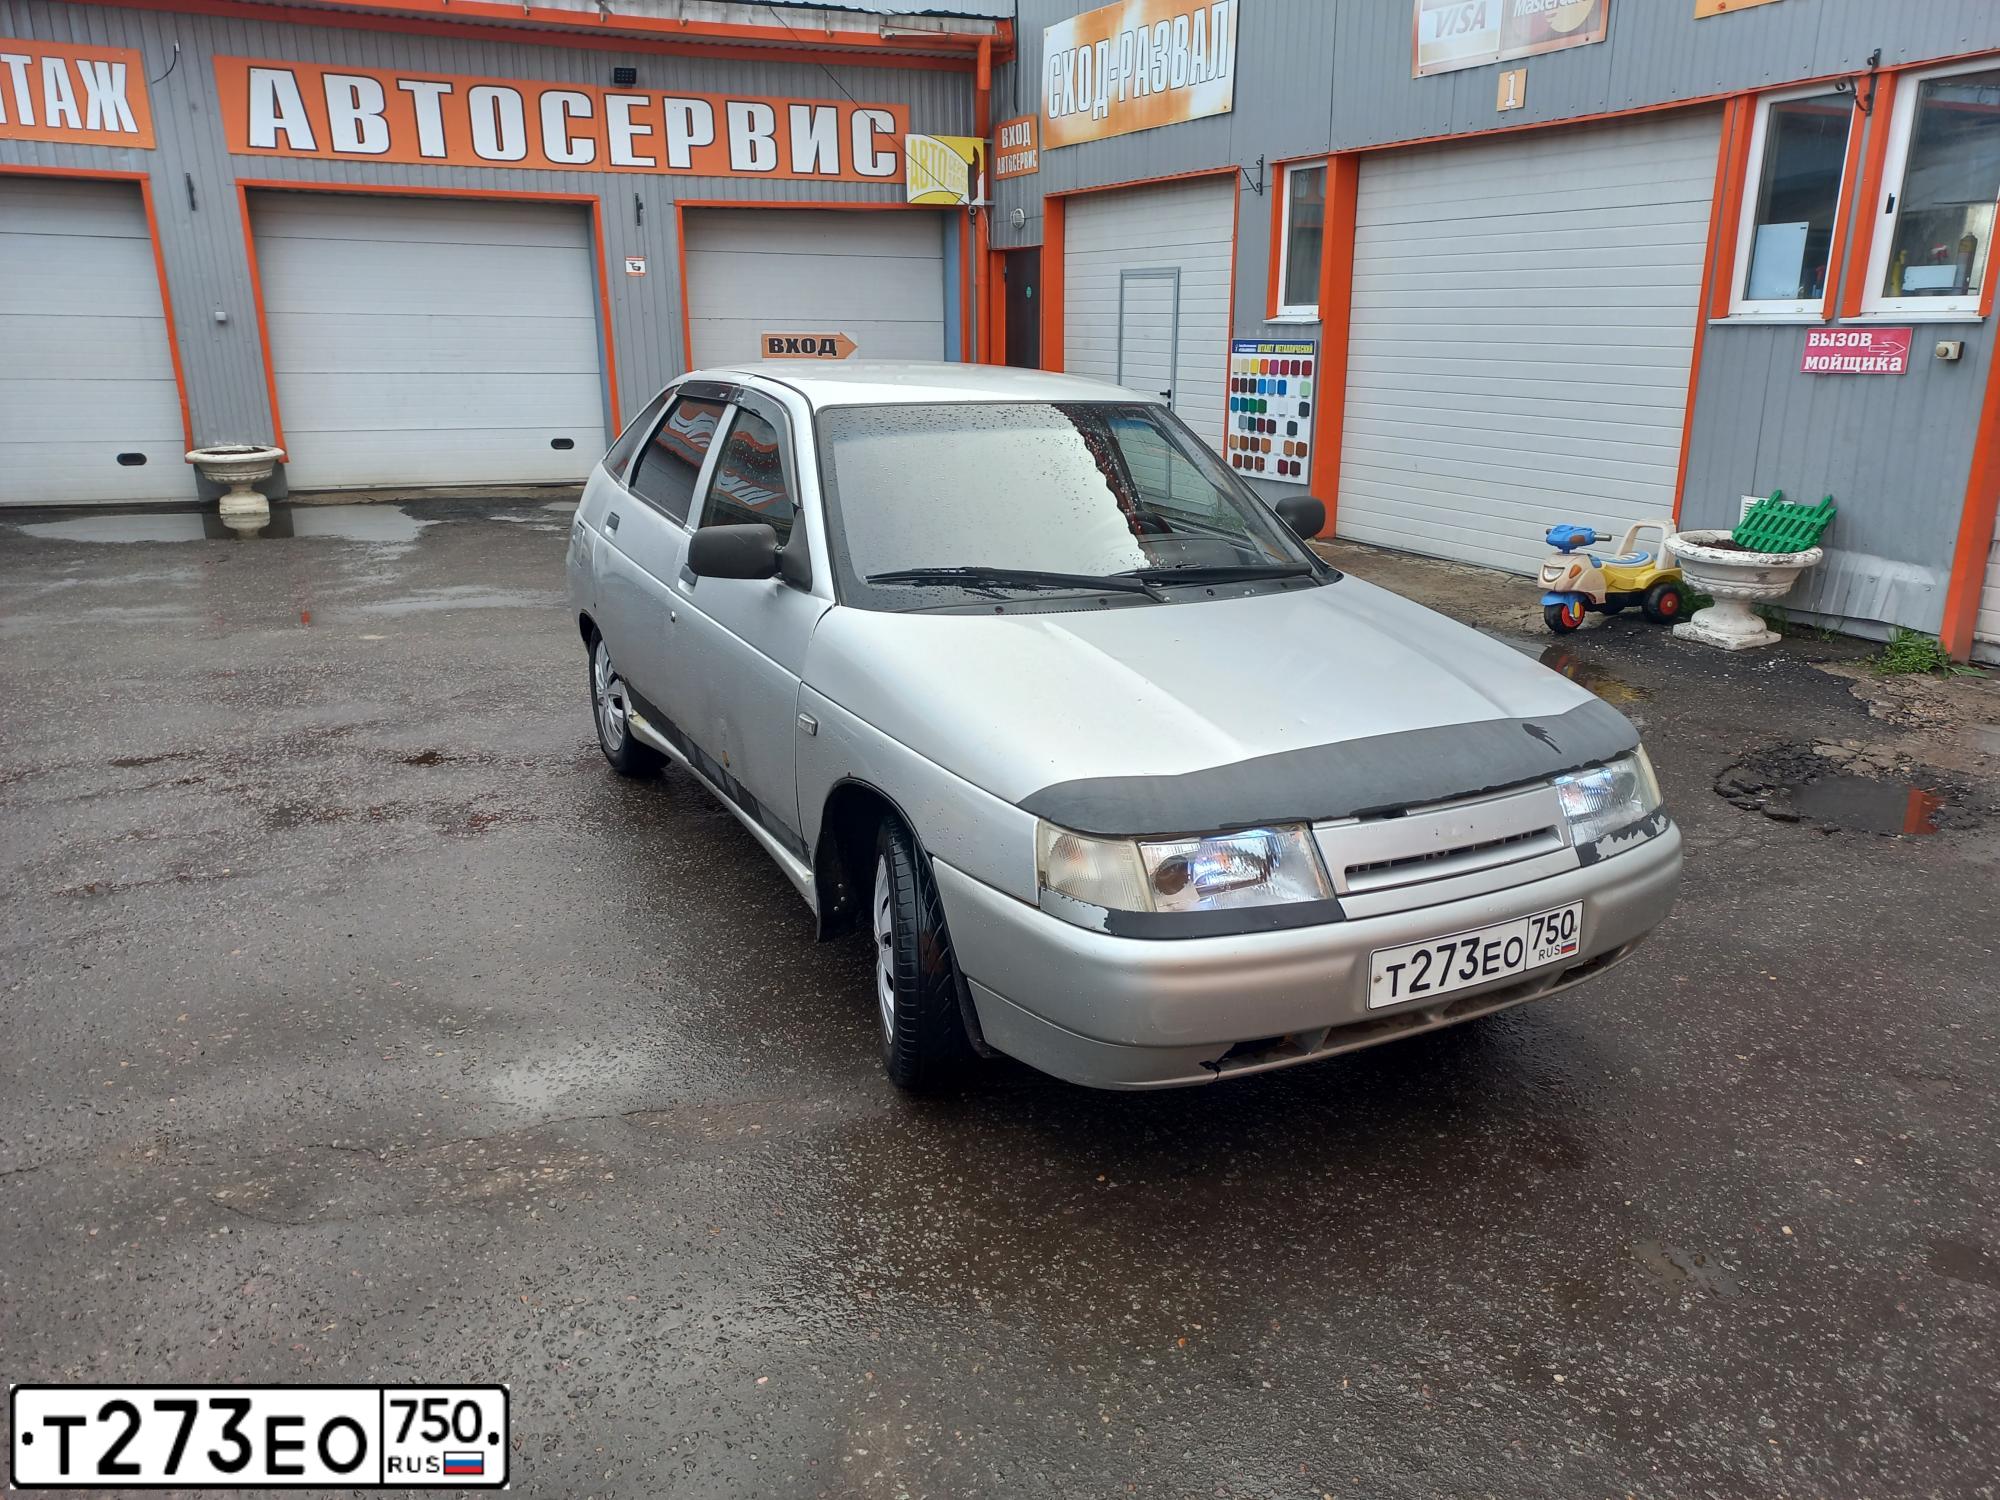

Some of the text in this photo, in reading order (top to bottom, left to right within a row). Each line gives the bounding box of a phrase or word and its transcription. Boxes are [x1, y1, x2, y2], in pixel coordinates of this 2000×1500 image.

[1435, 1, 1486, 38] VISA
[1048, 0, 1230, 121] СХОД-РАЗВАЛ
[0, 53, 139, 133] ТАЖ
[1504, 73, 1517, 107] 1
[247, 66, 898, 177] АВТОСЕРВИС
[1001, 121, 1031, 149] ВХОД
[910, 139, 947, 192] АВТО
[996, 150, 1037, 175] АВТОСЕРВИС
[767, 337, 837, 356] ВХОД
[1808, 333, 1873, 347] ВЫЗОВ
[1531, 909, 1575, 950] 750
[1538, 946, 1561, 961] RUS
